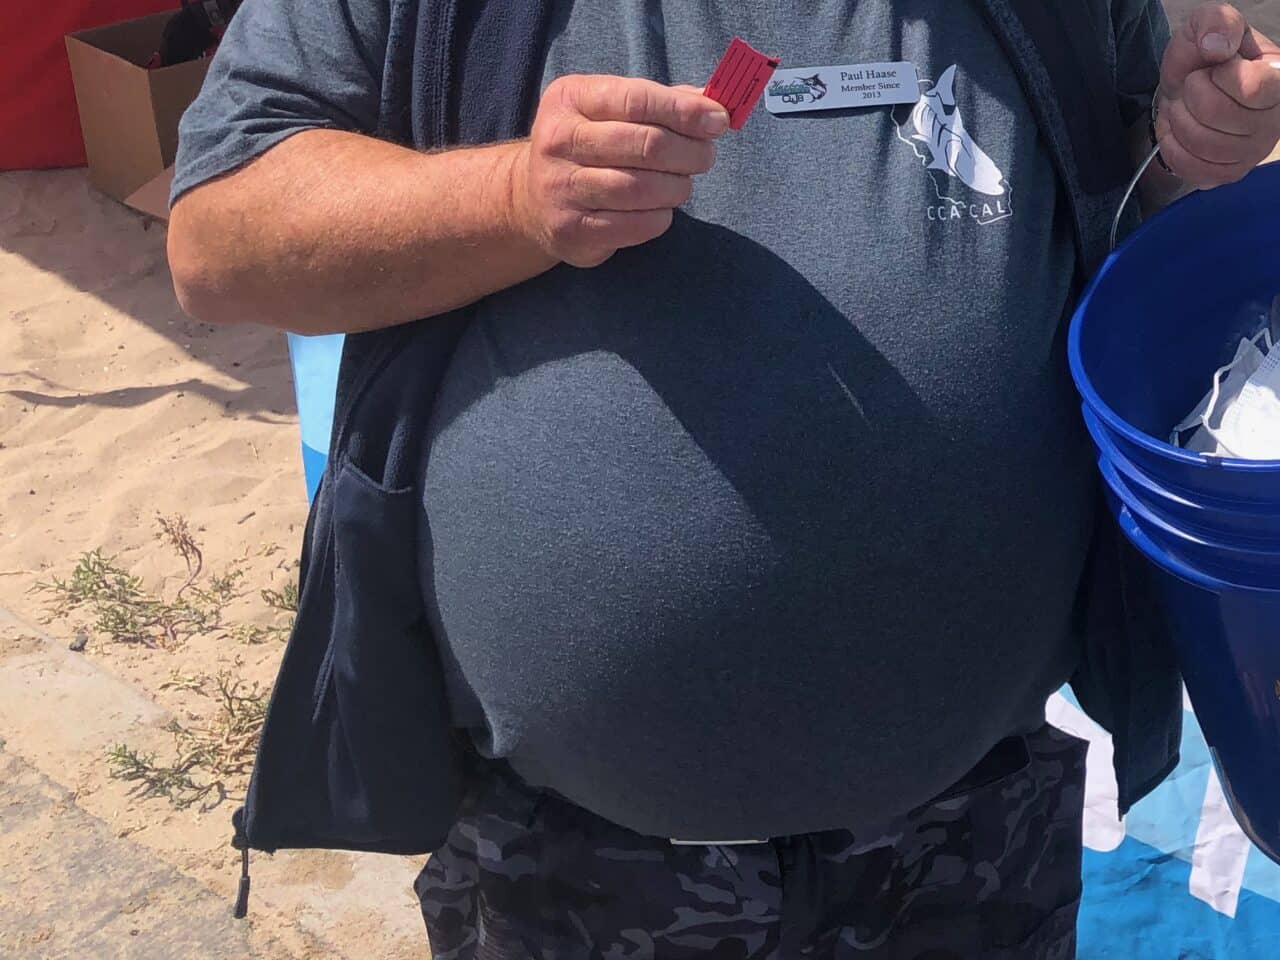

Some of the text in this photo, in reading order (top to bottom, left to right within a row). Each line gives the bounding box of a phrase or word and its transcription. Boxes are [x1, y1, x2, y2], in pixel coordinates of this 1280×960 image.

[840, 70, 897, 81] Paul Haase
[841, 81, 900, 93] Member Since
[862, 91, 882, 100] 2013
[926, 200, 1006, 221] CCA CAL
